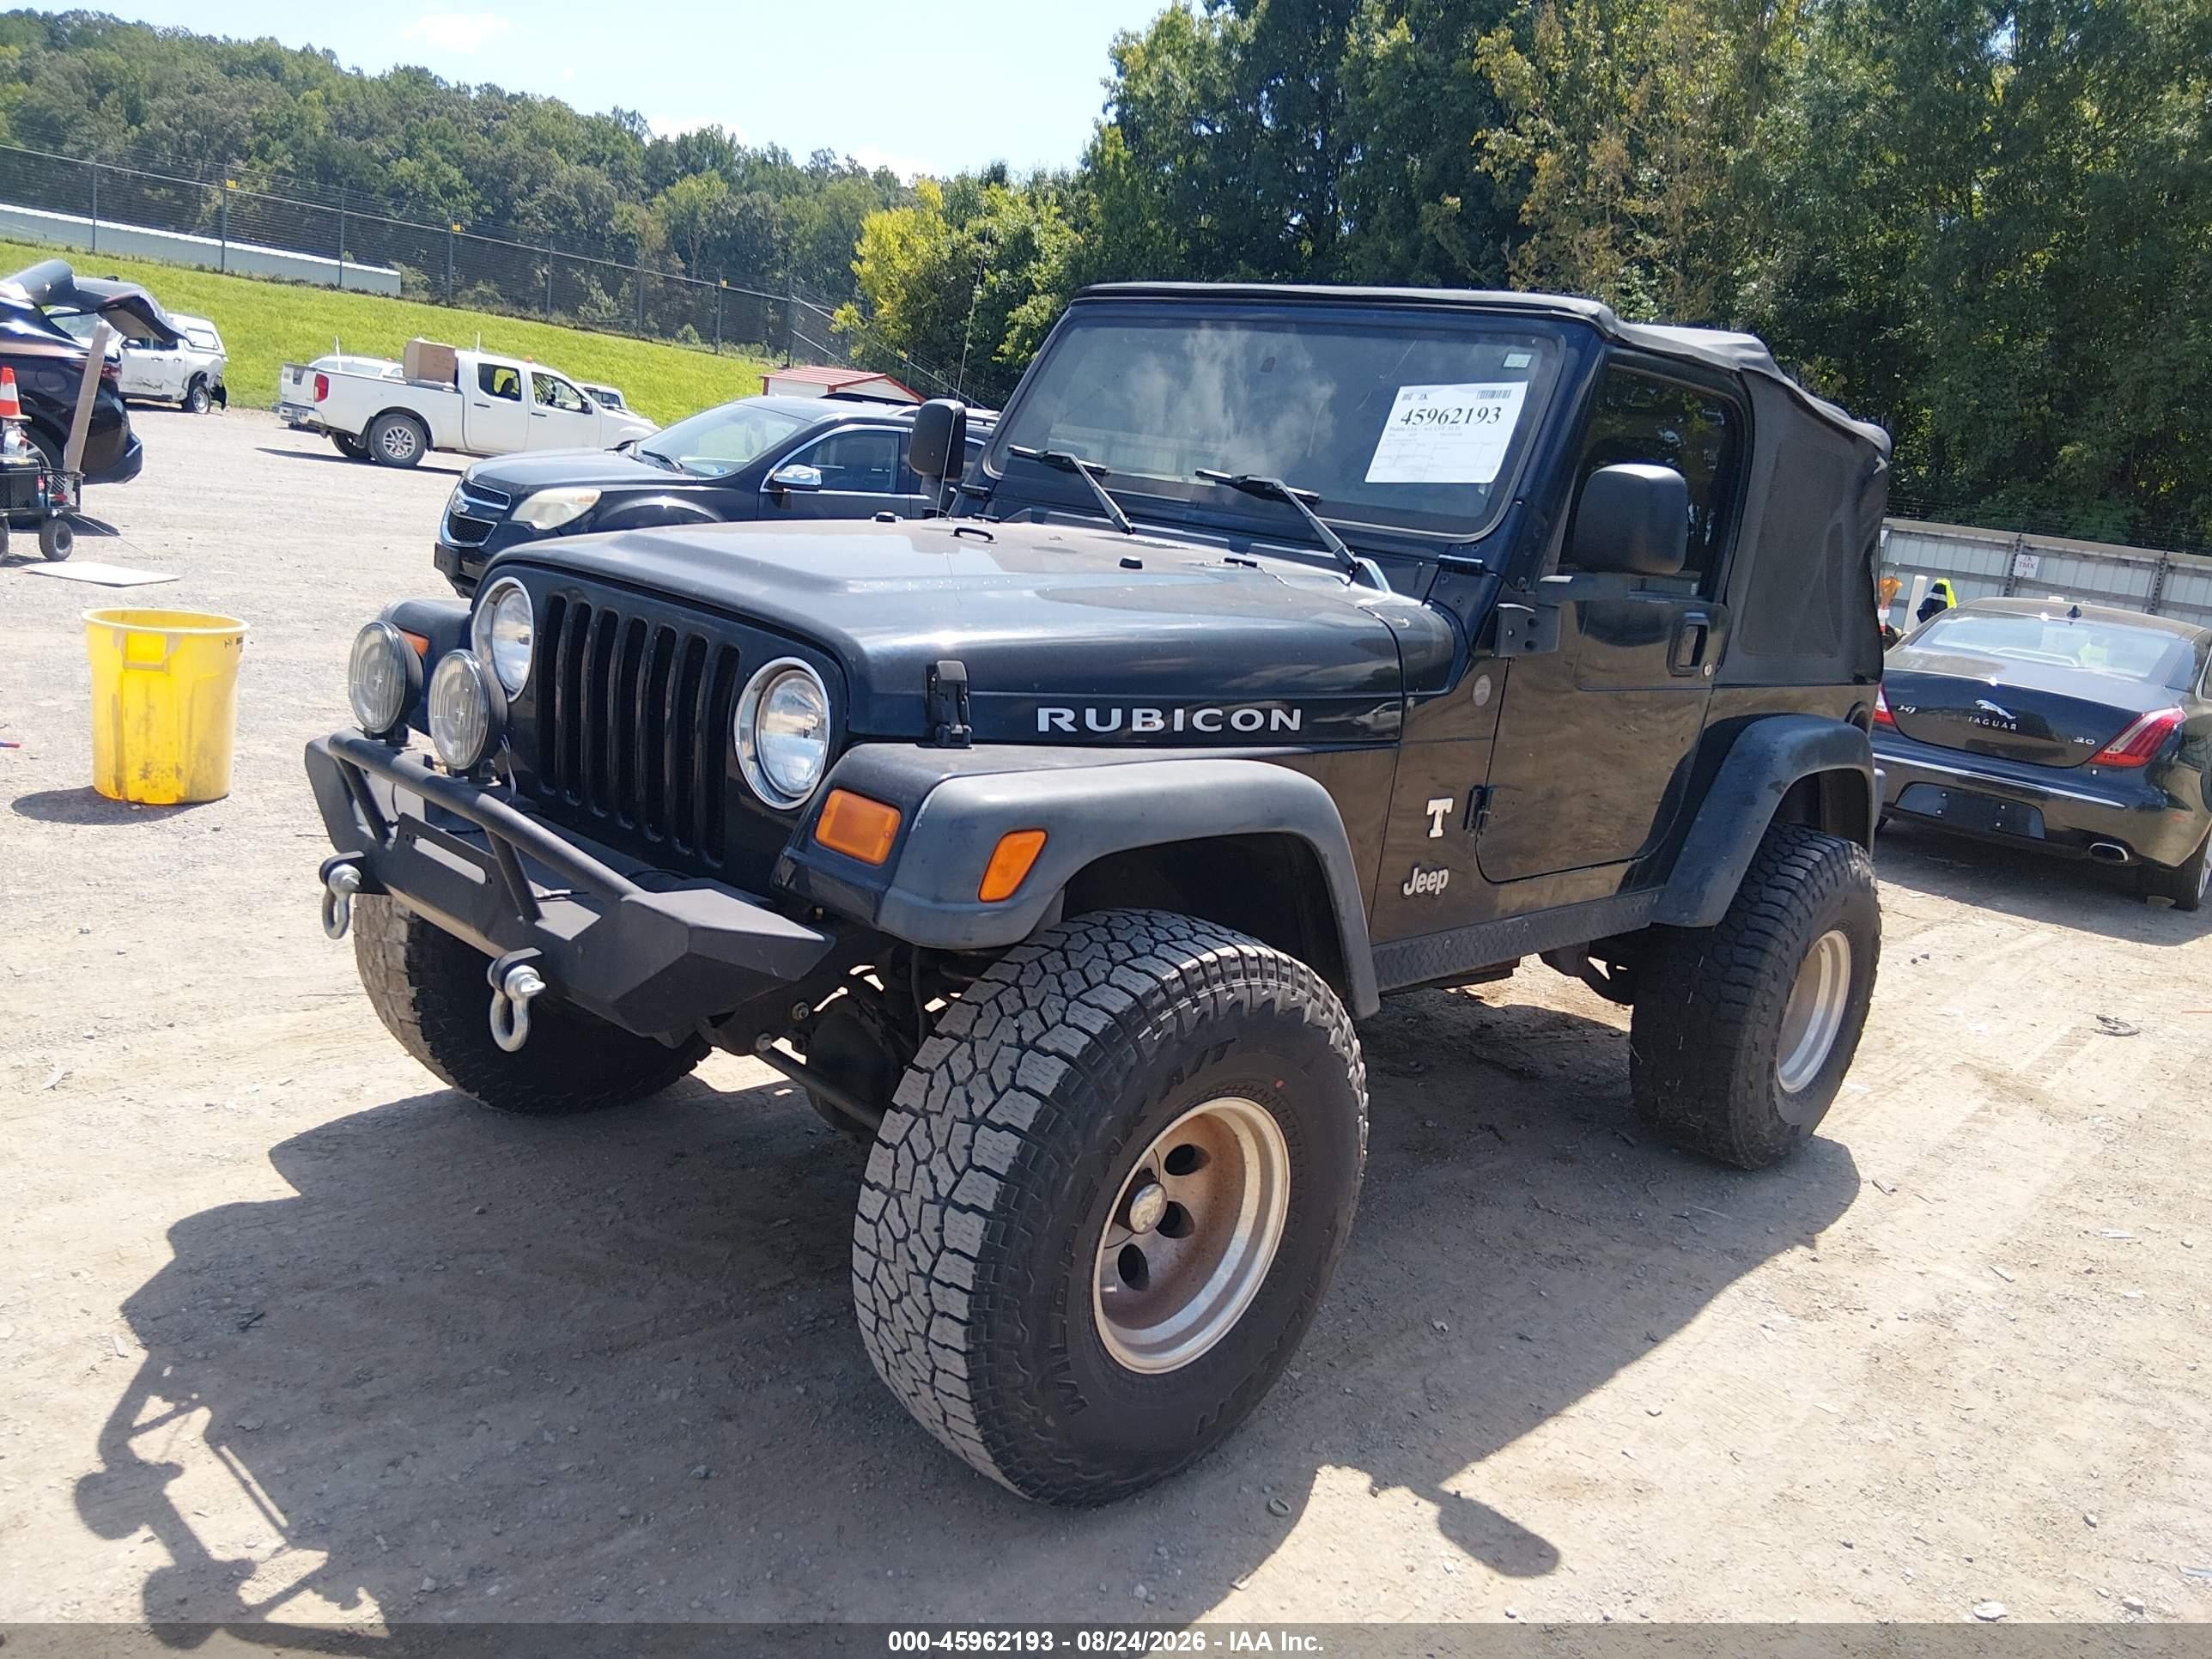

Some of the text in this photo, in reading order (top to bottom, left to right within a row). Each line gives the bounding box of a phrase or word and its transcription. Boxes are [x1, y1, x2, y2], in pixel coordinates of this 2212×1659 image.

[1401, 406, 1503, 426] 45962193
[1036, 708, 1302, 732] RUBICON
[1968, 715, 2018, 731] JAGUAR
[1426, 797, 1454, 838] T
[1402, 866, 1449, 896] Jeep
